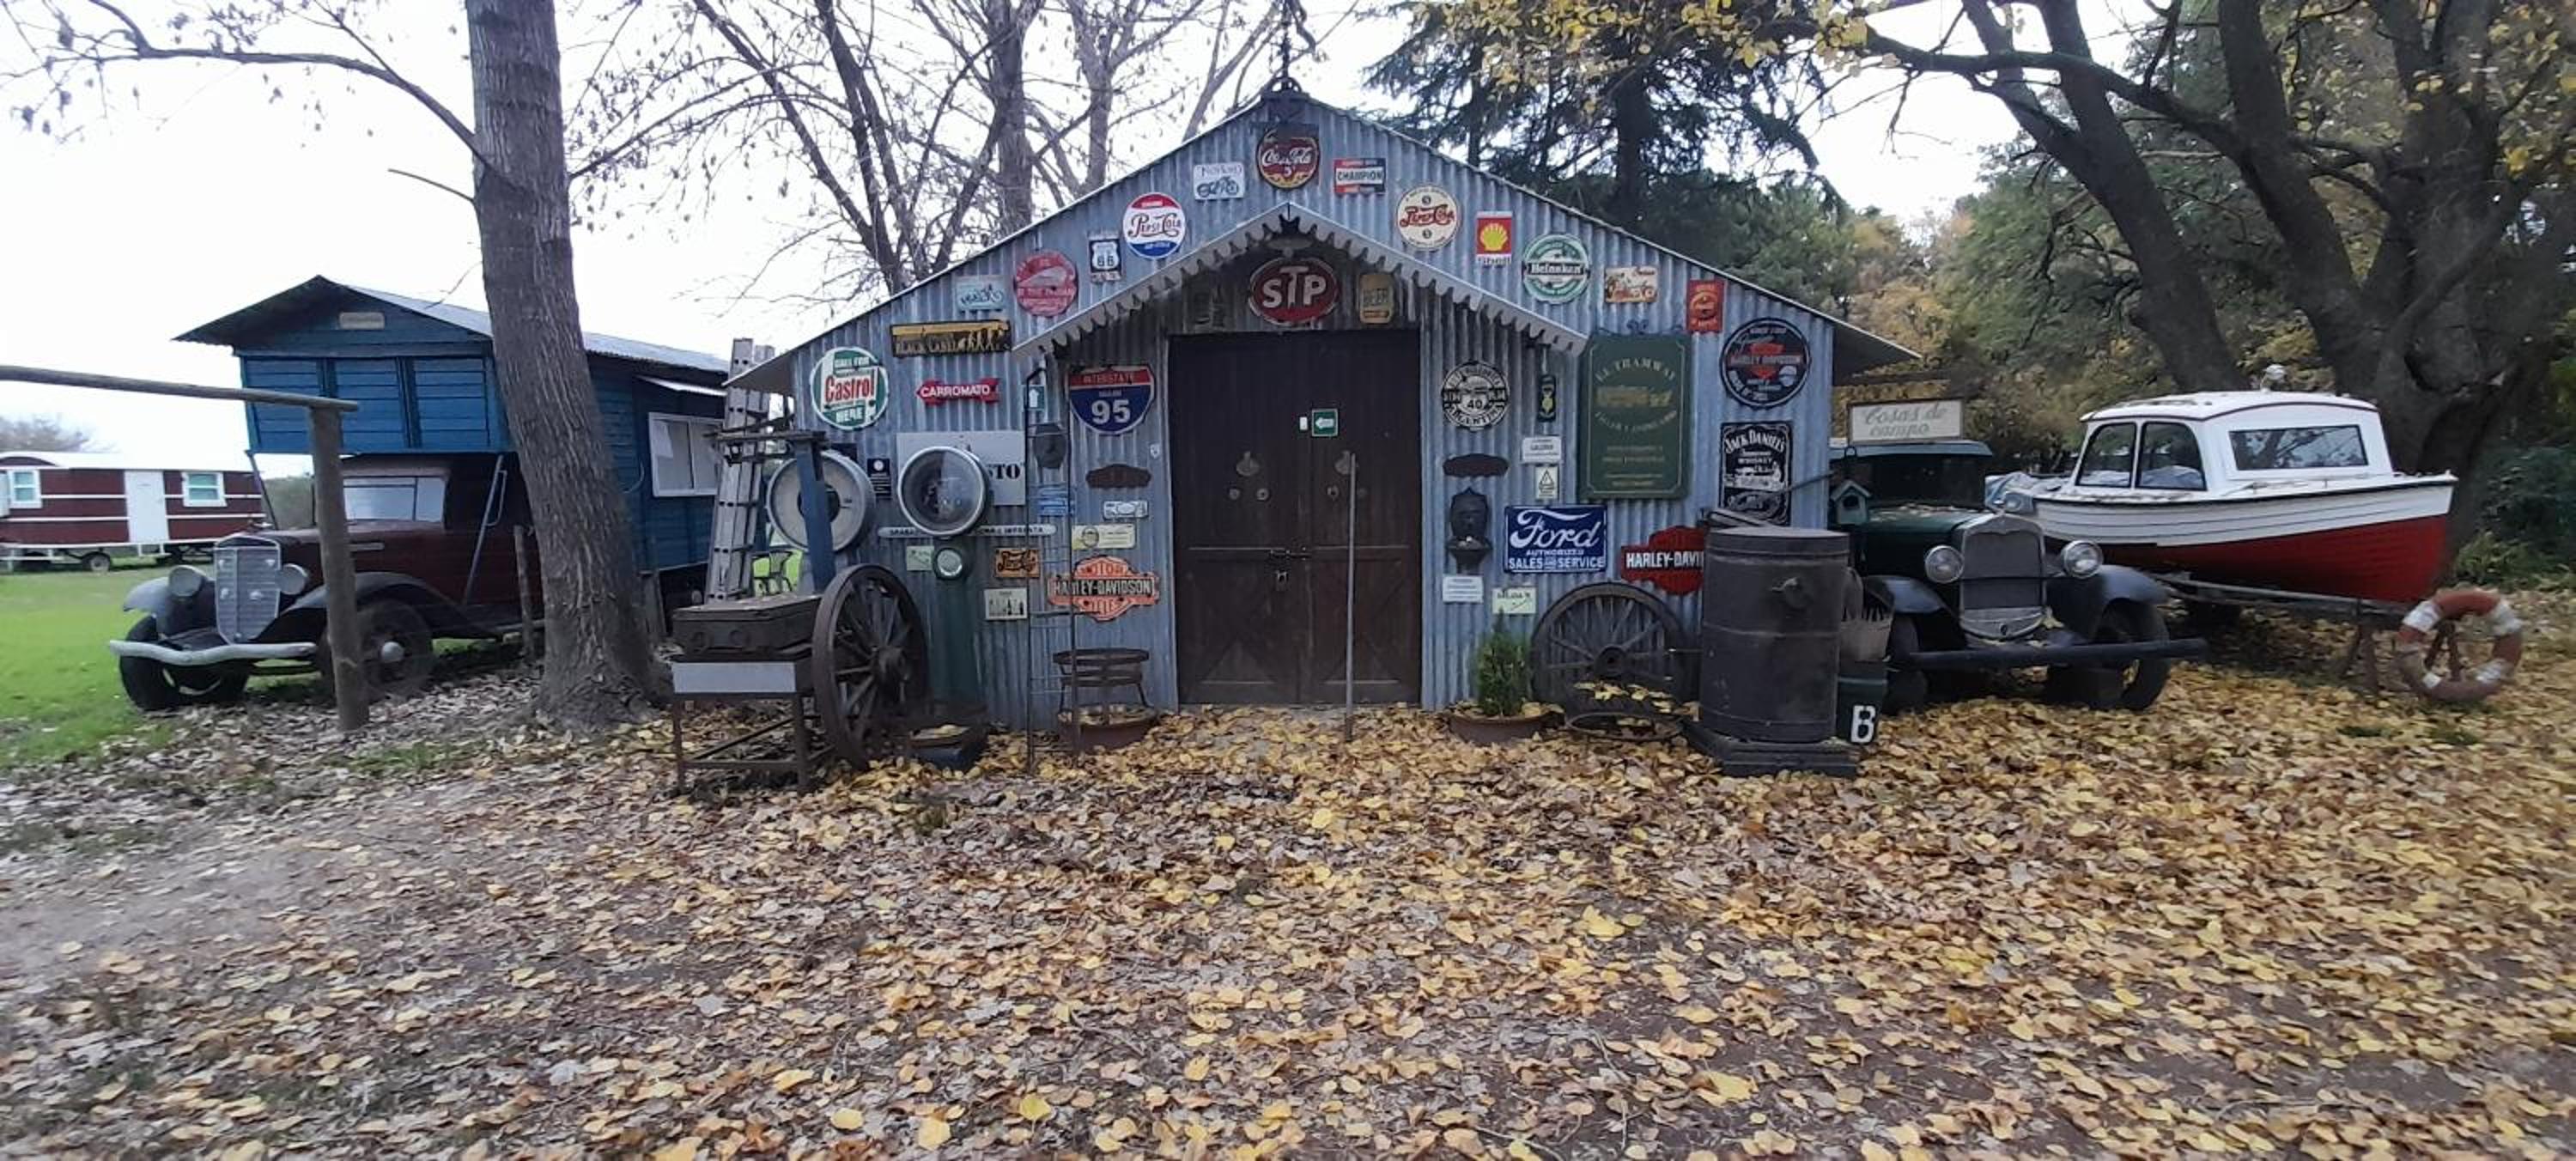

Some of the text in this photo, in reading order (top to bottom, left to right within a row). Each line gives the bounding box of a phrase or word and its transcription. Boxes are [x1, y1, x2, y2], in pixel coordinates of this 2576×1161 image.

[1337, 169, 1383, 181] CHAMPION
[1530, 262, 1582, 274] Heineken
[1262, 264, 1327, 310] STP
[825, 375, 875, 403] Castrol
[920, 384, 990, 397] CARROMATO
[1091, 399, 1132, 424] 95
[1467, 399, 1484, 410] 40
[1510, 508, 1601, 548] Ford
[1509, 557, 1543, 569] SALES
[1558, 556, 1605, 568] SERVICE
[1850, 704, 1877, 744] B
